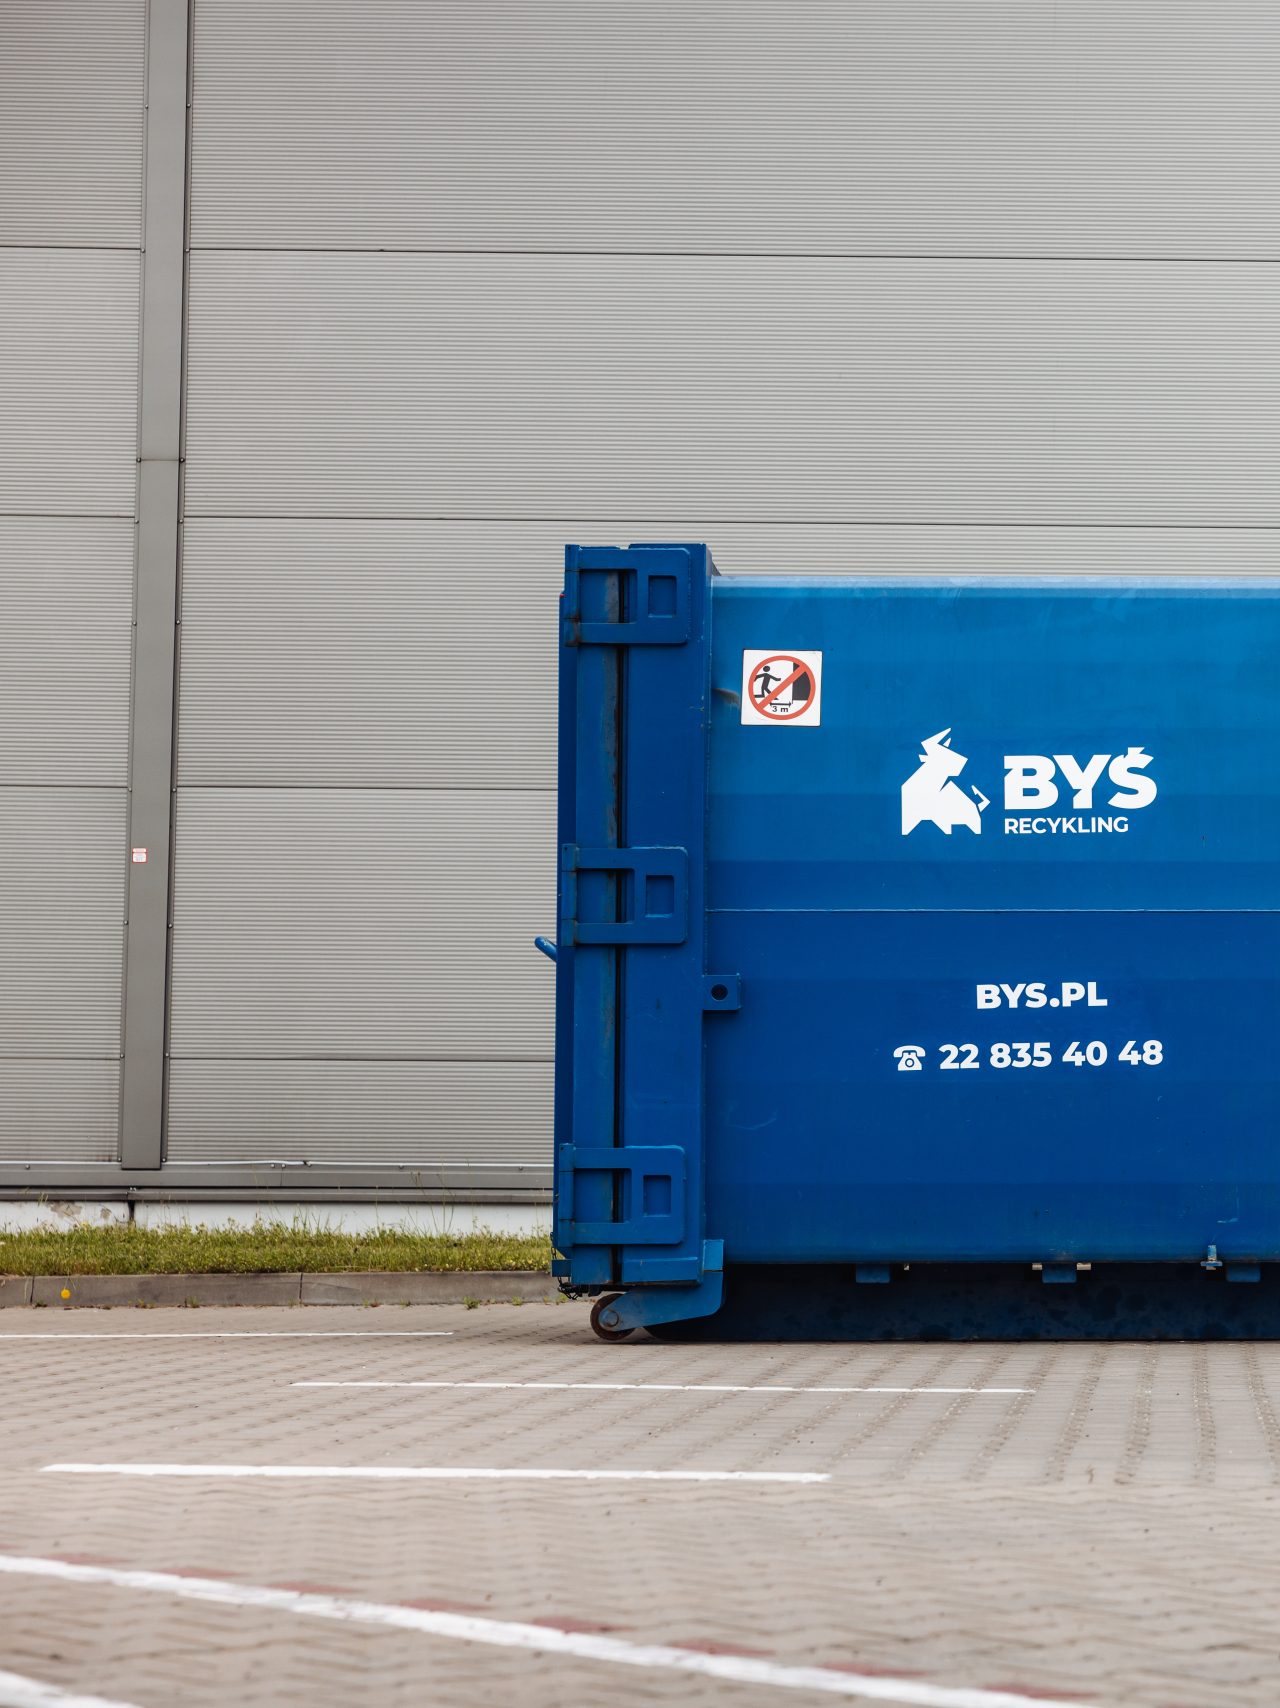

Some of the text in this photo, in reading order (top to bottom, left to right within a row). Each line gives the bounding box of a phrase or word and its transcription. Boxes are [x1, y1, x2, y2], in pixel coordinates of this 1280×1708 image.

[1003, 746, 1158, 810] BYŚ
[1004, 816, 1129, 834] RECYKLING
[976, 981, 1108, 1010] BYS.PL
[938, 1039, 1164, 1070] 22 835 40 48
